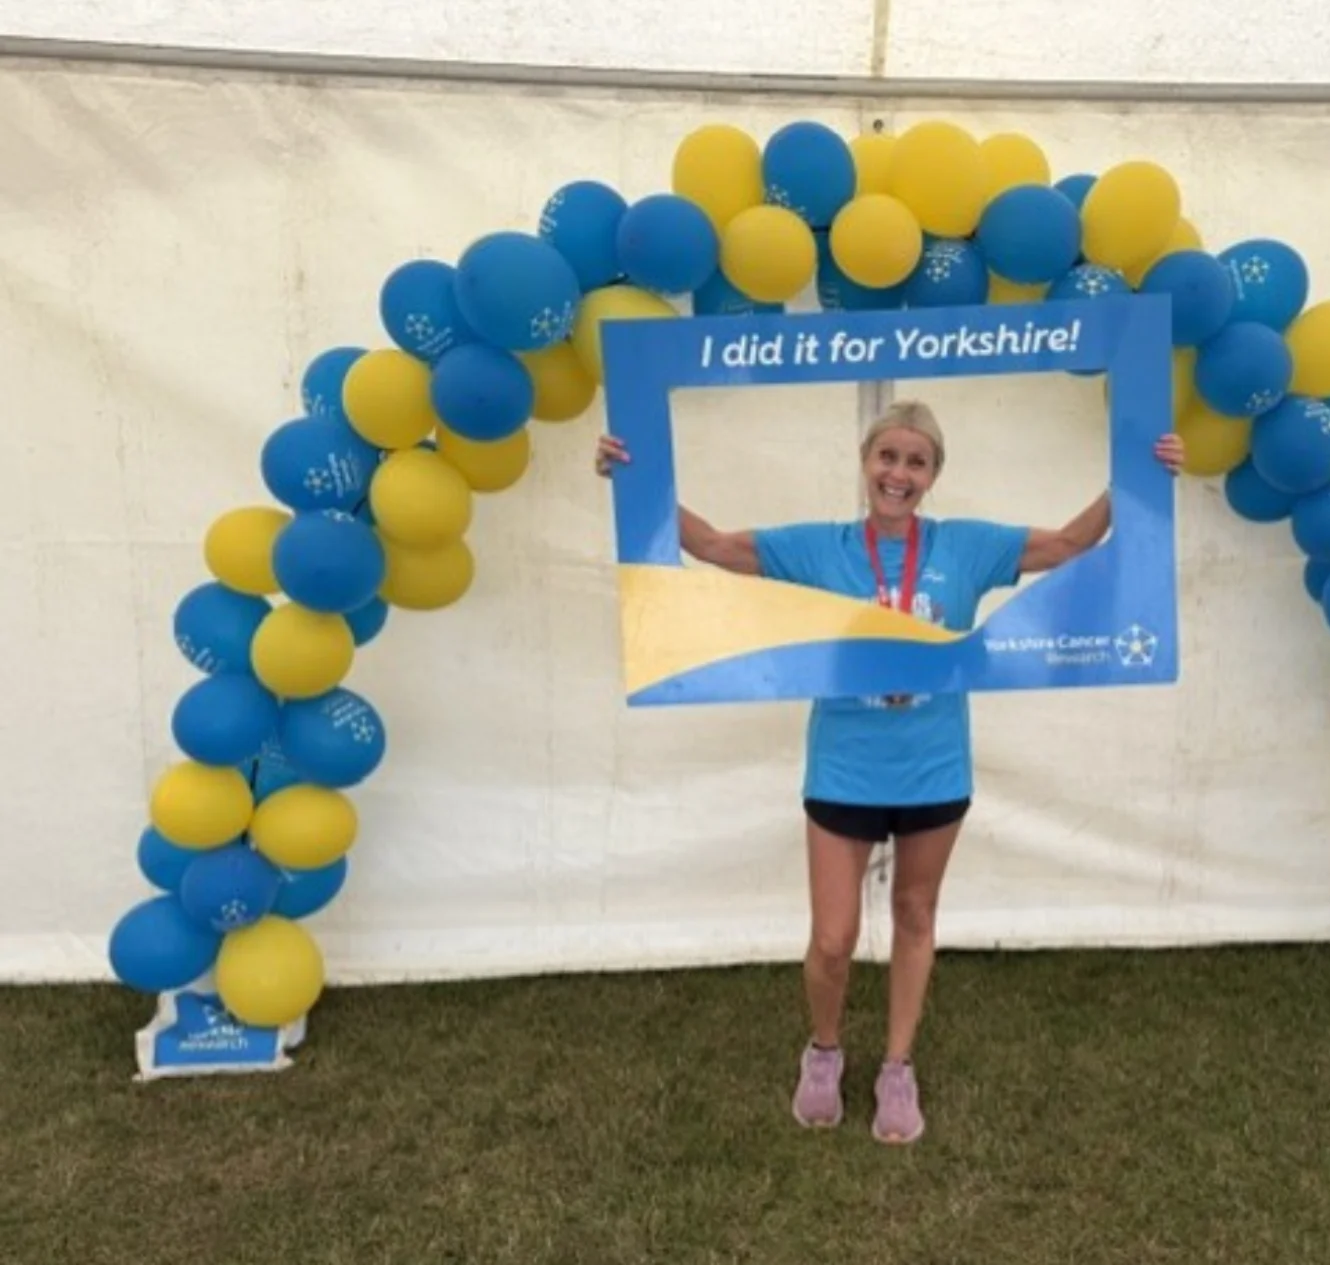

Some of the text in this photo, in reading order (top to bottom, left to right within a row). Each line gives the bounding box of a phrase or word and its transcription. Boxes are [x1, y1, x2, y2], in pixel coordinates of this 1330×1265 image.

[701, 319, 1082, 368] I did it for Yorkshire!
[984, 634, 1111, 652] Yorkshire Cancer
[1046, 651, 1112, 666] Research
